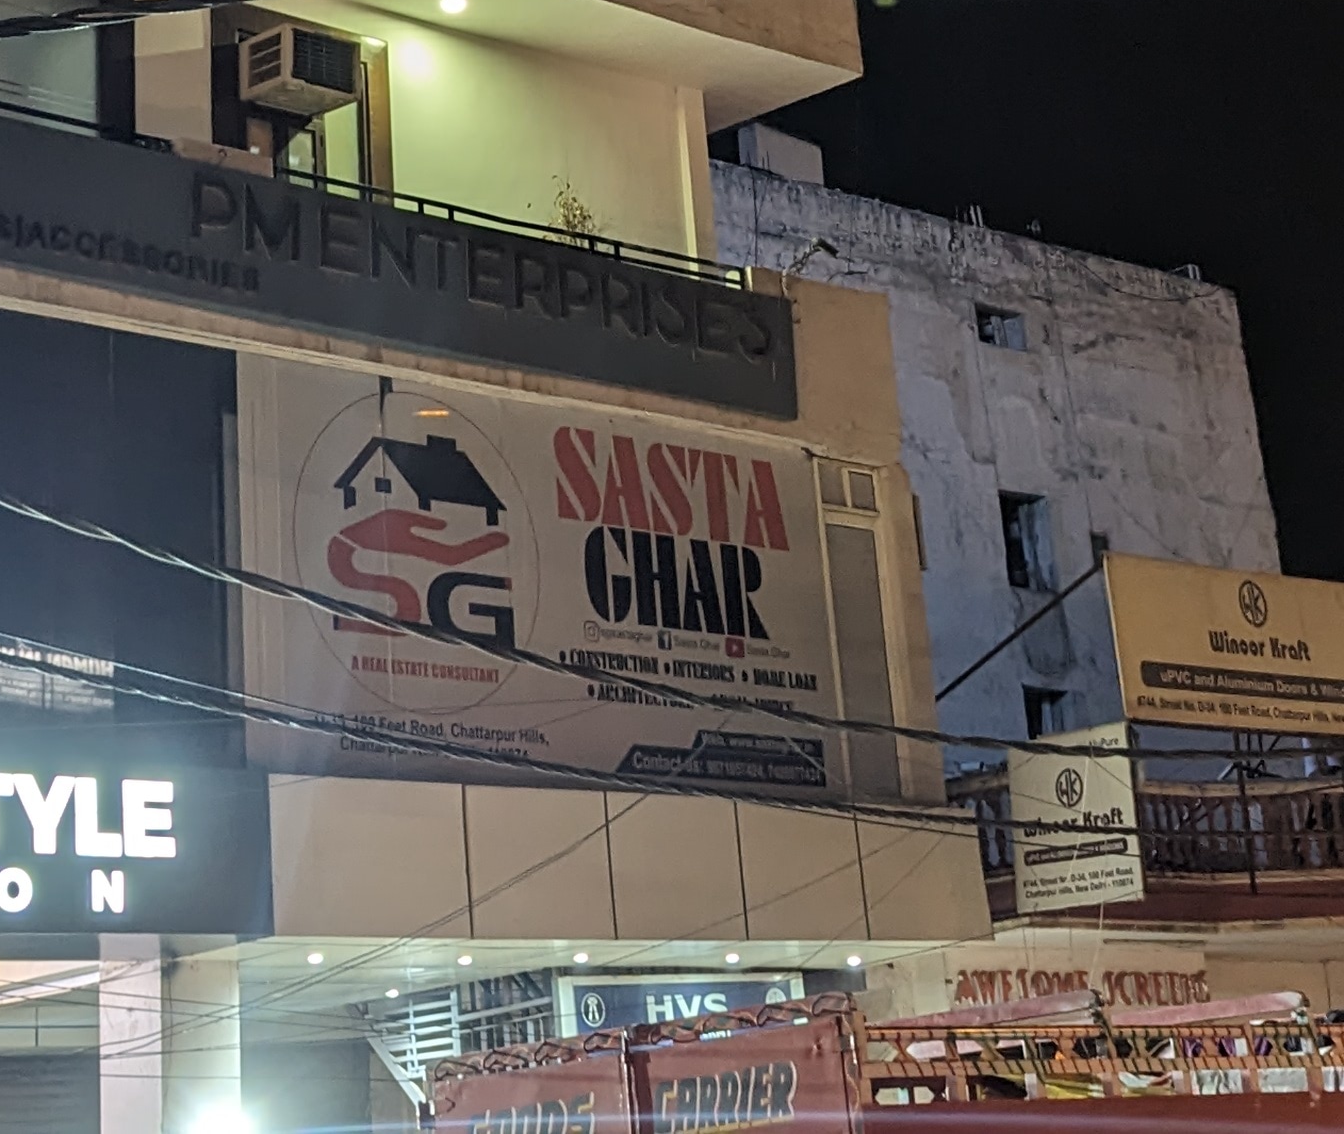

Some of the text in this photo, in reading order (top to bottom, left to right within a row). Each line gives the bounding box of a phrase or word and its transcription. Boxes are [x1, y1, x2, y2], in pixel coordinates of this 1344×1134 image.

[191, 168, 774, 360] PM ENTERPRISES
[553, 426, 790, 552] SASTA
[584, 525, 770, 641] GHAR
[1269, 637, 1312, 662] Kraft
[351, 655, 500, 684] A REAL ESTATE CONSULTANT
[569, 647, 818, 691] CONSTRUCTION INTERIORS HOME LOAN
[1194, 673, 1214, 687] and
[1217, 674, 1274, 692] Aluminium
[450, 722, 516, 748] Chattarpur
[1082, 807, 1124, 827] Kraft
[646, 993, 729, 1025] HVS
[654, 1061, 795, 1133] CARRIER
